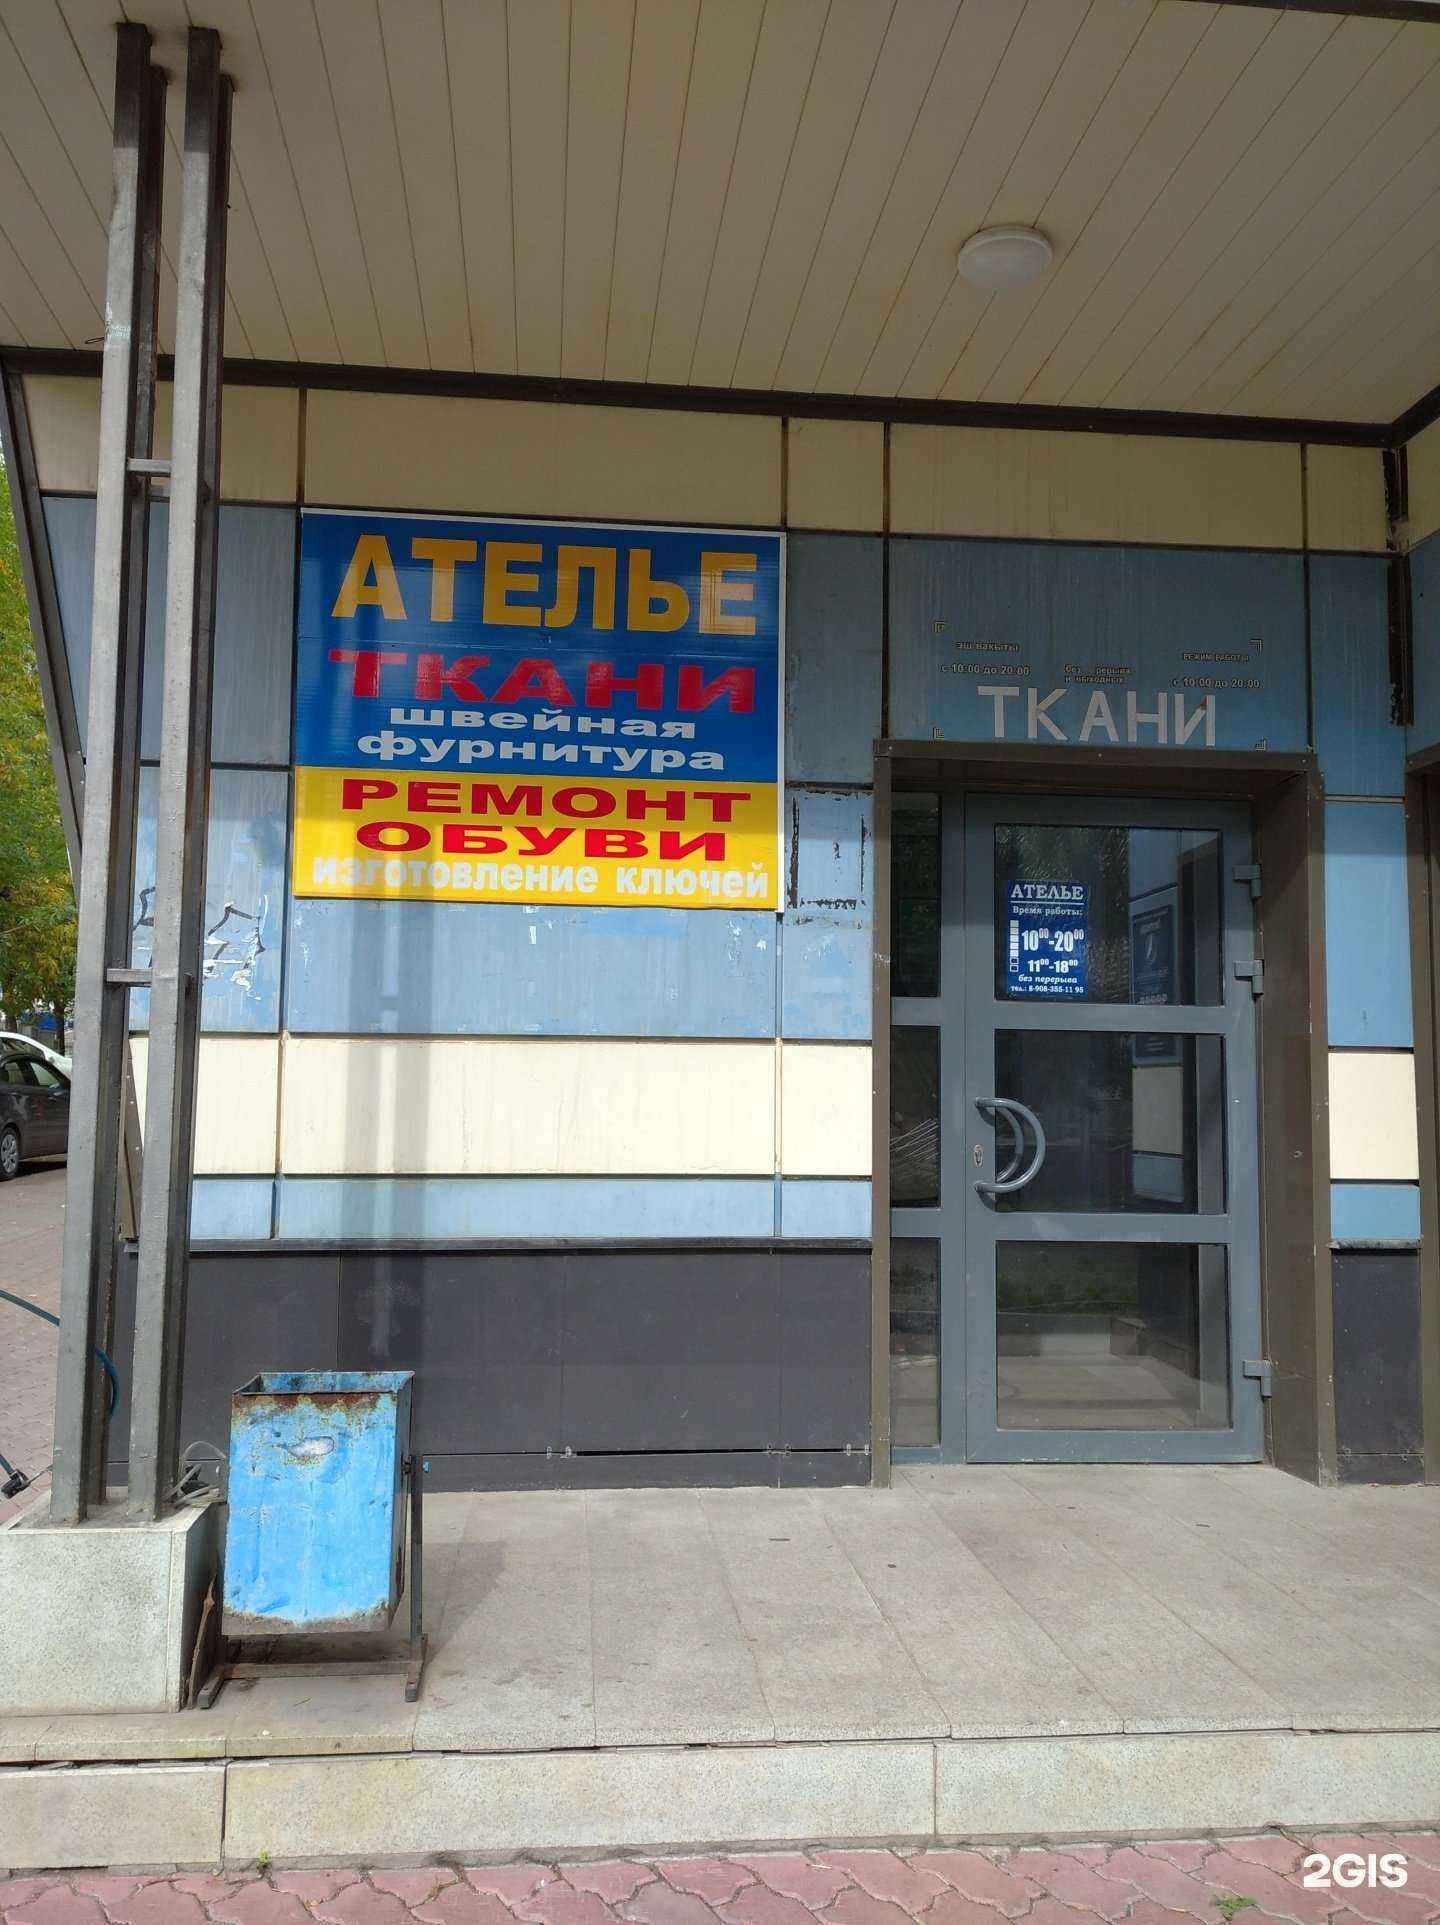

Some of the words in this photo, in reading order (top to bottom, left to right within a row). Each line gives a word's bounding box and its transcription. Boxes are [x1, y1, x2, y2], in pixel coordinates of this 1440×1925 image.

[331, 534, 757, 636] АТЕЛЬЕ
[328, 648, 755, 713] ТКАНИ
[952, 663, 980, 674] 10:00
[390, 707, 696, 739] швейная
[977, 685, 1216, 747] ТКАНИ
[357, 730, 725, 773] фурнитура
[341, 778, 751, 823] РЕМОНТ
[356, 821, 726, 861] ОБУВИ
[312, 855, 598, 893] изготовление
[616, 862, 768, 898] ключей
[1011, 884, 1084, 900] АТЕЛЬЕ
[1013, 906, 1042, 915] Время
[1018, 974, 1033, 982] без
[1035, 976, 1078, 984] перерыва
